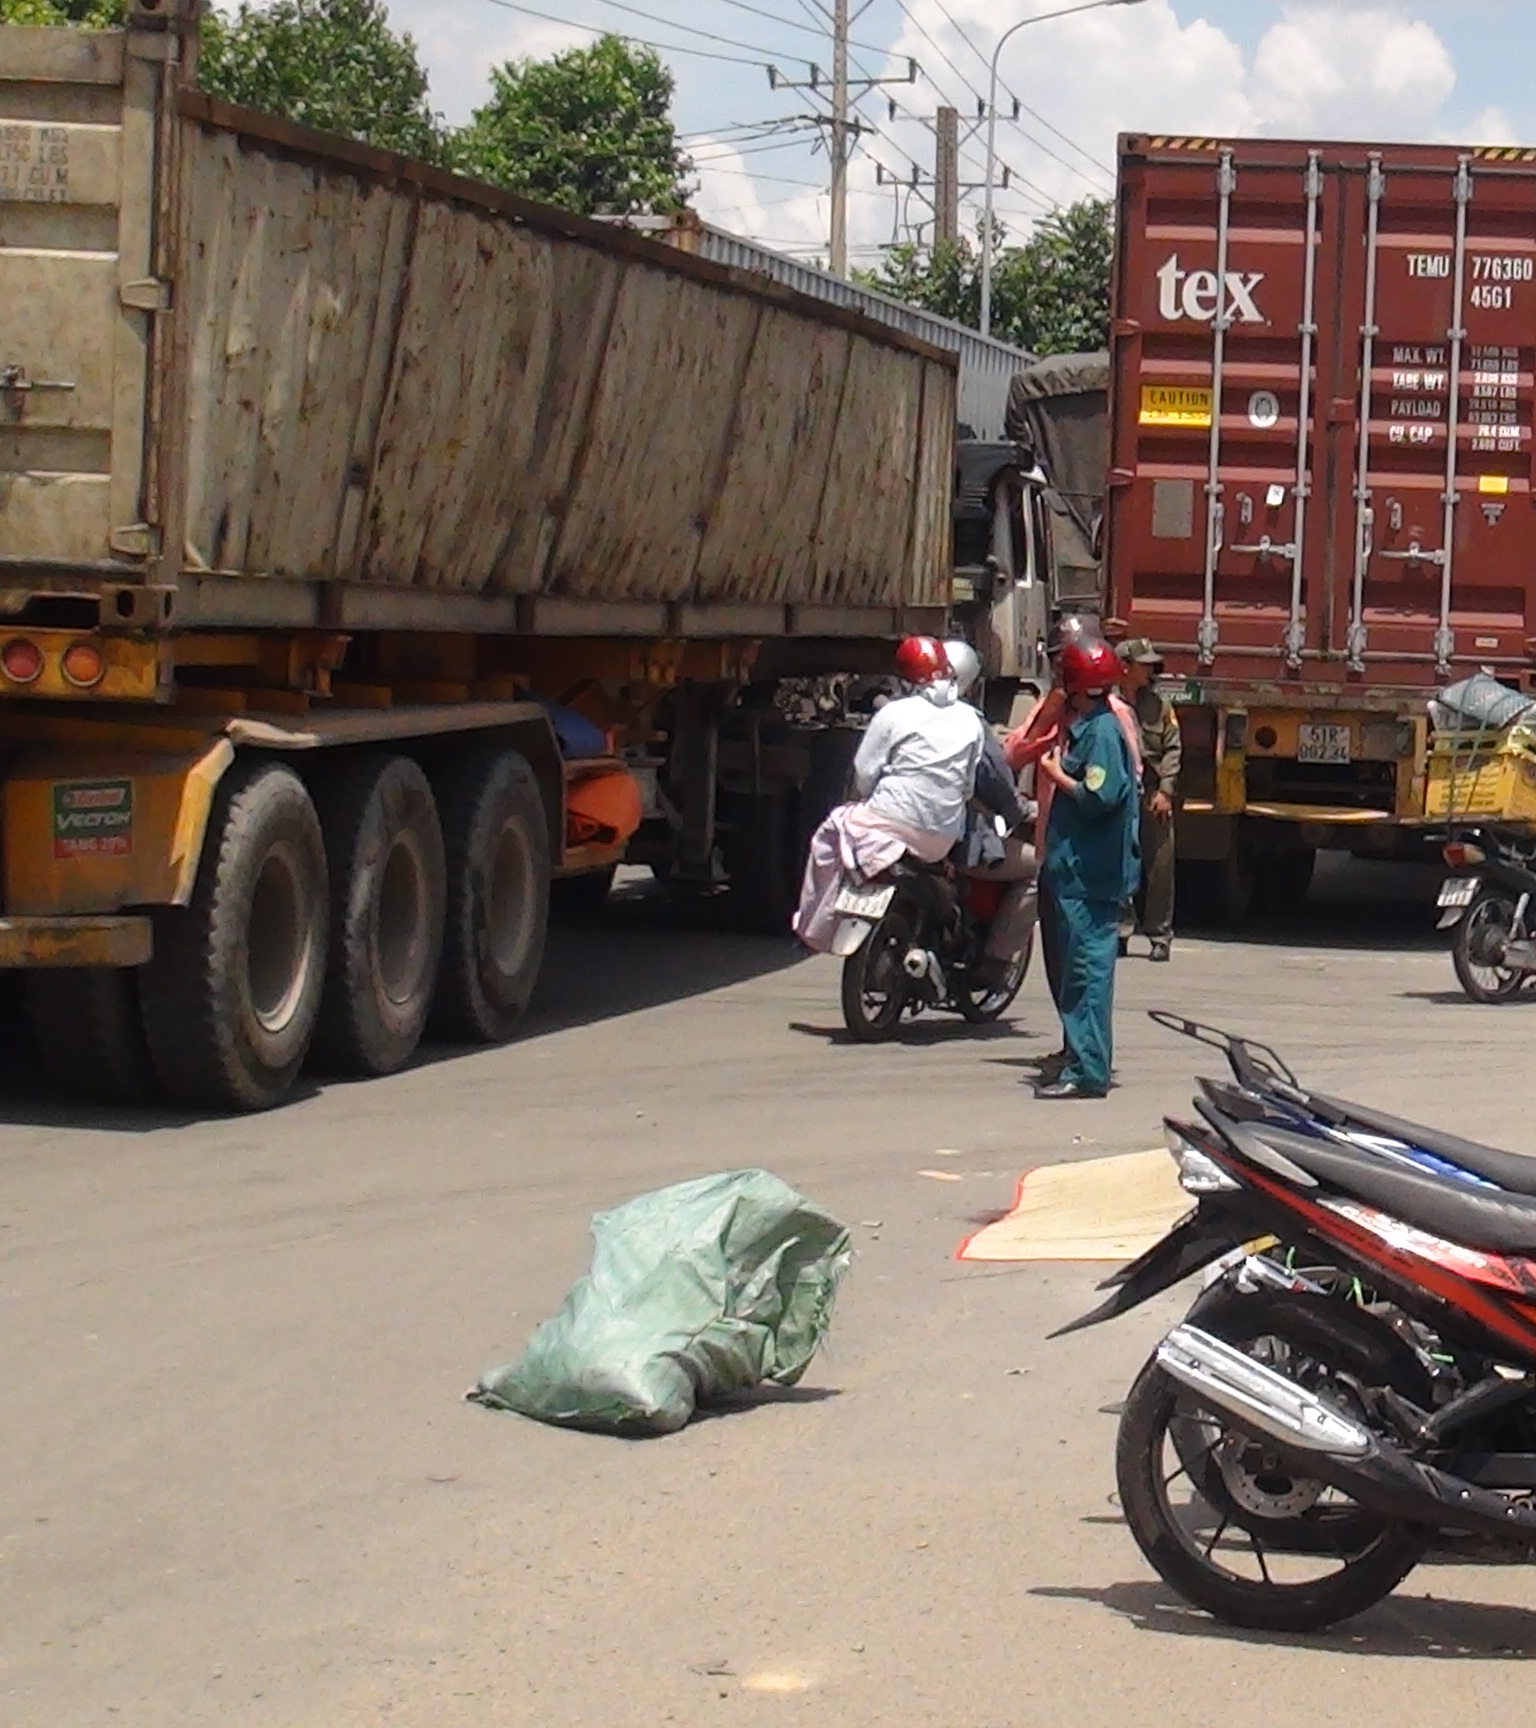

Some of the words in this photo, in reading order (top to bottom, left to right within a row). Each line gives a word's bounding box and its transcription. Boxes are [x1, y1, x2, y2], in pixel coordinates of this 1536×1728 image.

[1407, 254, 1449, 277] TEMU
[1472, 256, 1533, 281] 776360
[1156, 253, 1265, 321] tex
[1470, 285, 1512, 309] 45G1
[1150, 389, 1208, 405] CAUTION
[1391, 401, 1441, 418] PAYLOAD
